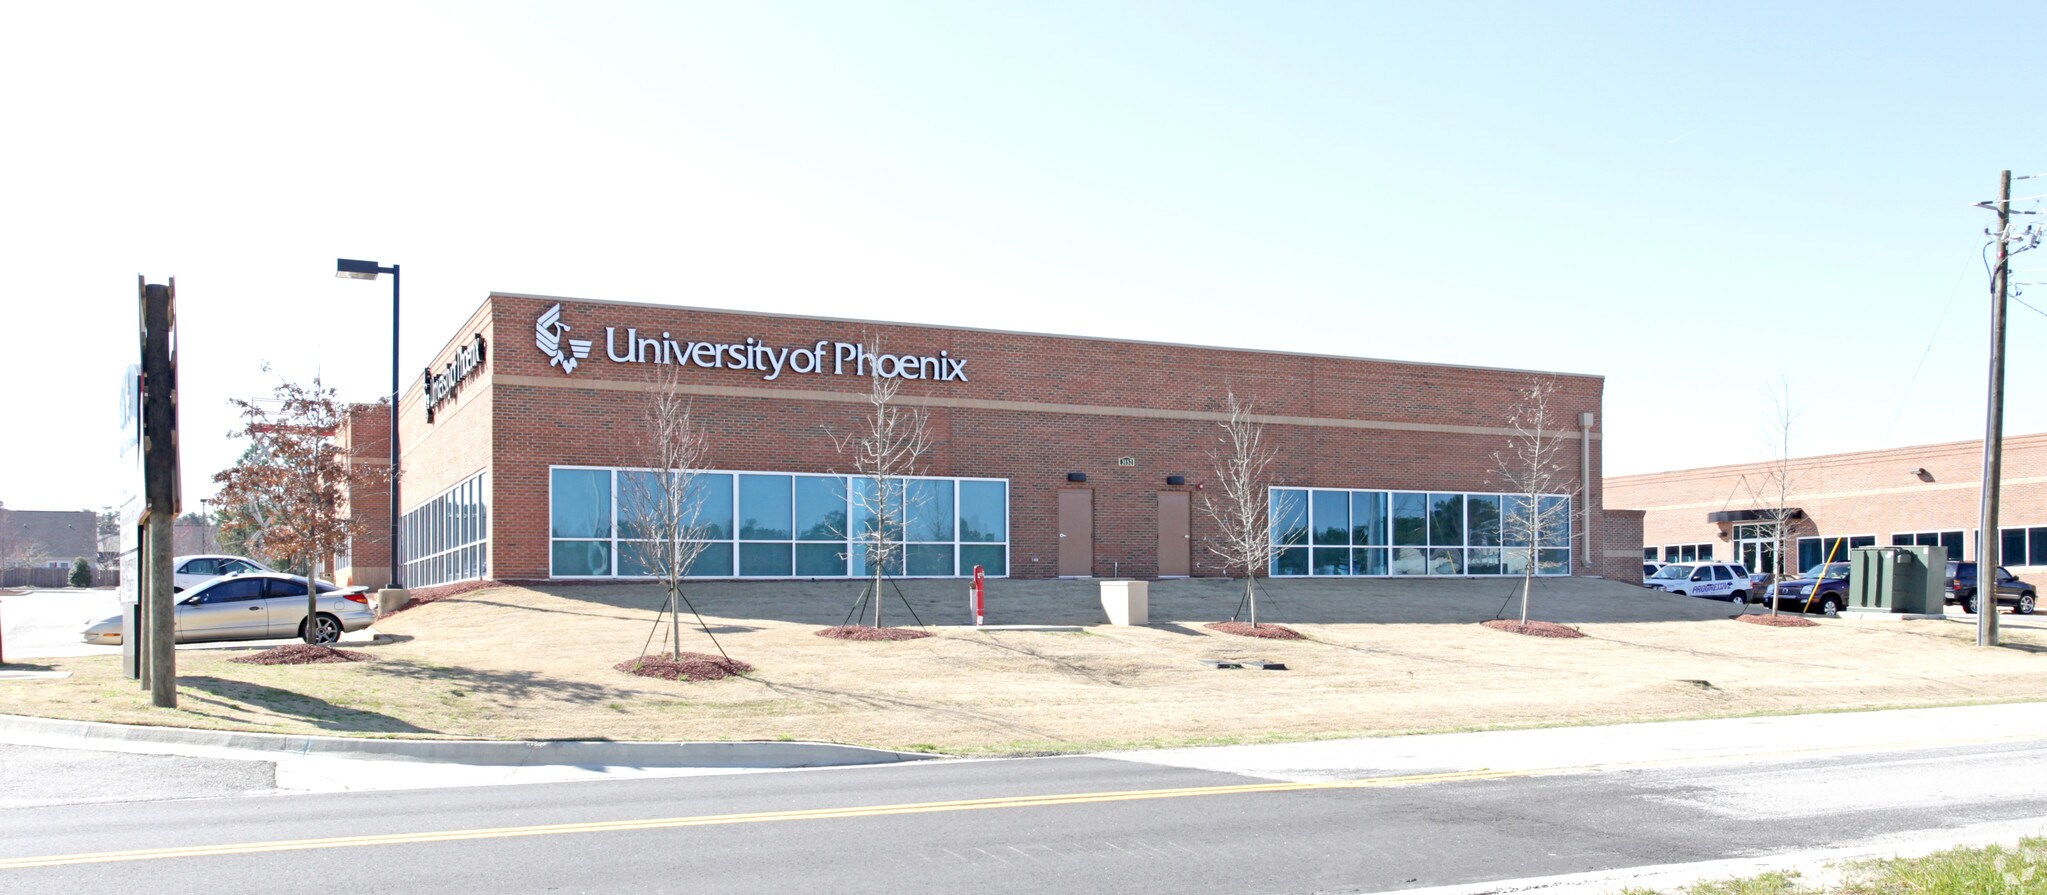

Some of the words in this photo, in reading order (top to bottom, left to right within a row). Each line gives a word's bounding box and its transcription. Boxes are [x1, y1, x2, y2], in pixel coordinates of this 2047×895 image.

[606, 327, 787, 381] University
[790, 341, 828, 374] of
[834, 342, 969, 382] Phoenix
